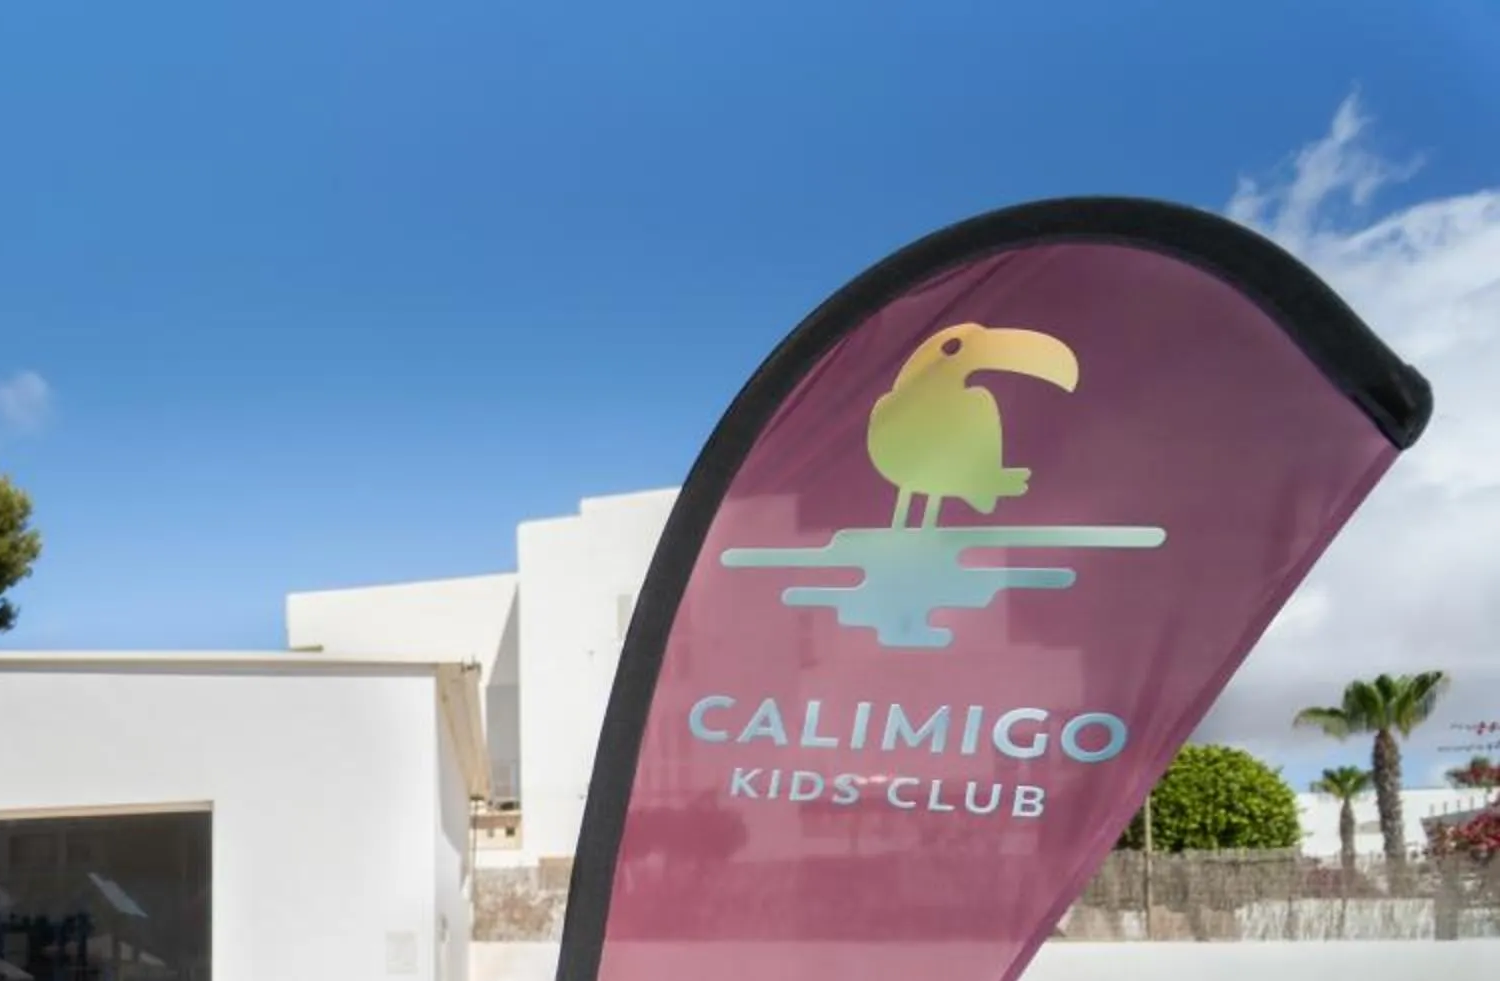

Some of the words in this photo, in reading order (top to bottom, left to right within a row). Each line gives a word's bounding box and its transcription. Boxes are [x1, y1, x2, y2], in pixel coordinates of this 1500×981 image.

[688, 695, 1129, 763] CALIMIGO
[729, 766, 861, 805] KIDS
[885, 776, 1046, 818] CLUB
